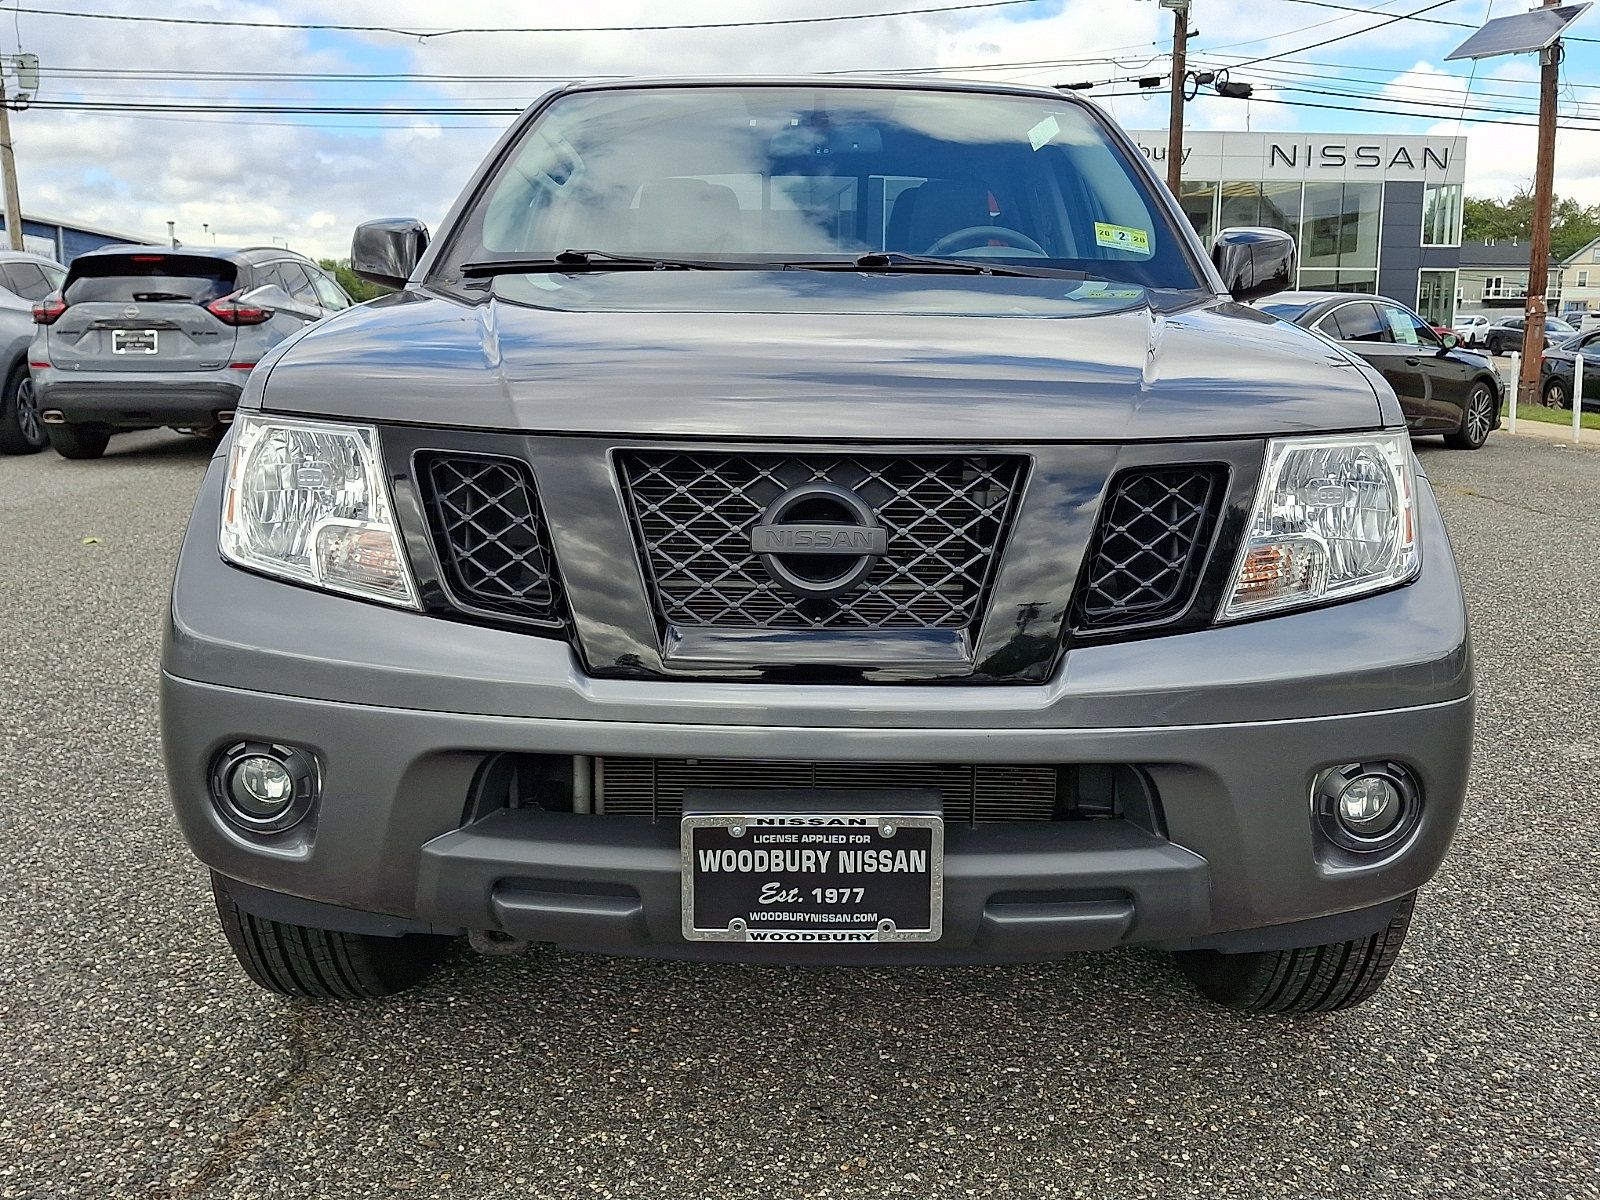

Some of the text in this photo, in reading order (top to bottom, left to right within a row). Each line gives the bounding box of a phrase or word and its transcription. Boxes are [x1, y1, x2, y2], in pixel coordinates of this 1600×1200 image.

[1138, 143, 1192, 165] buy
[1269, 144, 1449, 170] NISSAN
[1118, 231, 1126, 241] 2
[765, 530, 873, 549] NISSAN
[756, 817, 867, 826] NISSAN
[753, 834, 871, 844] LICENSE APPLIED FOR
[699, 849, 926, 873] WOODBURY NISSAN
[757, 881, 865, 905] Est. 1977
[749, 911, 878, 923] WOODBURYNISSAN.COM
[750, 932, 876, 942] WOODBURY
